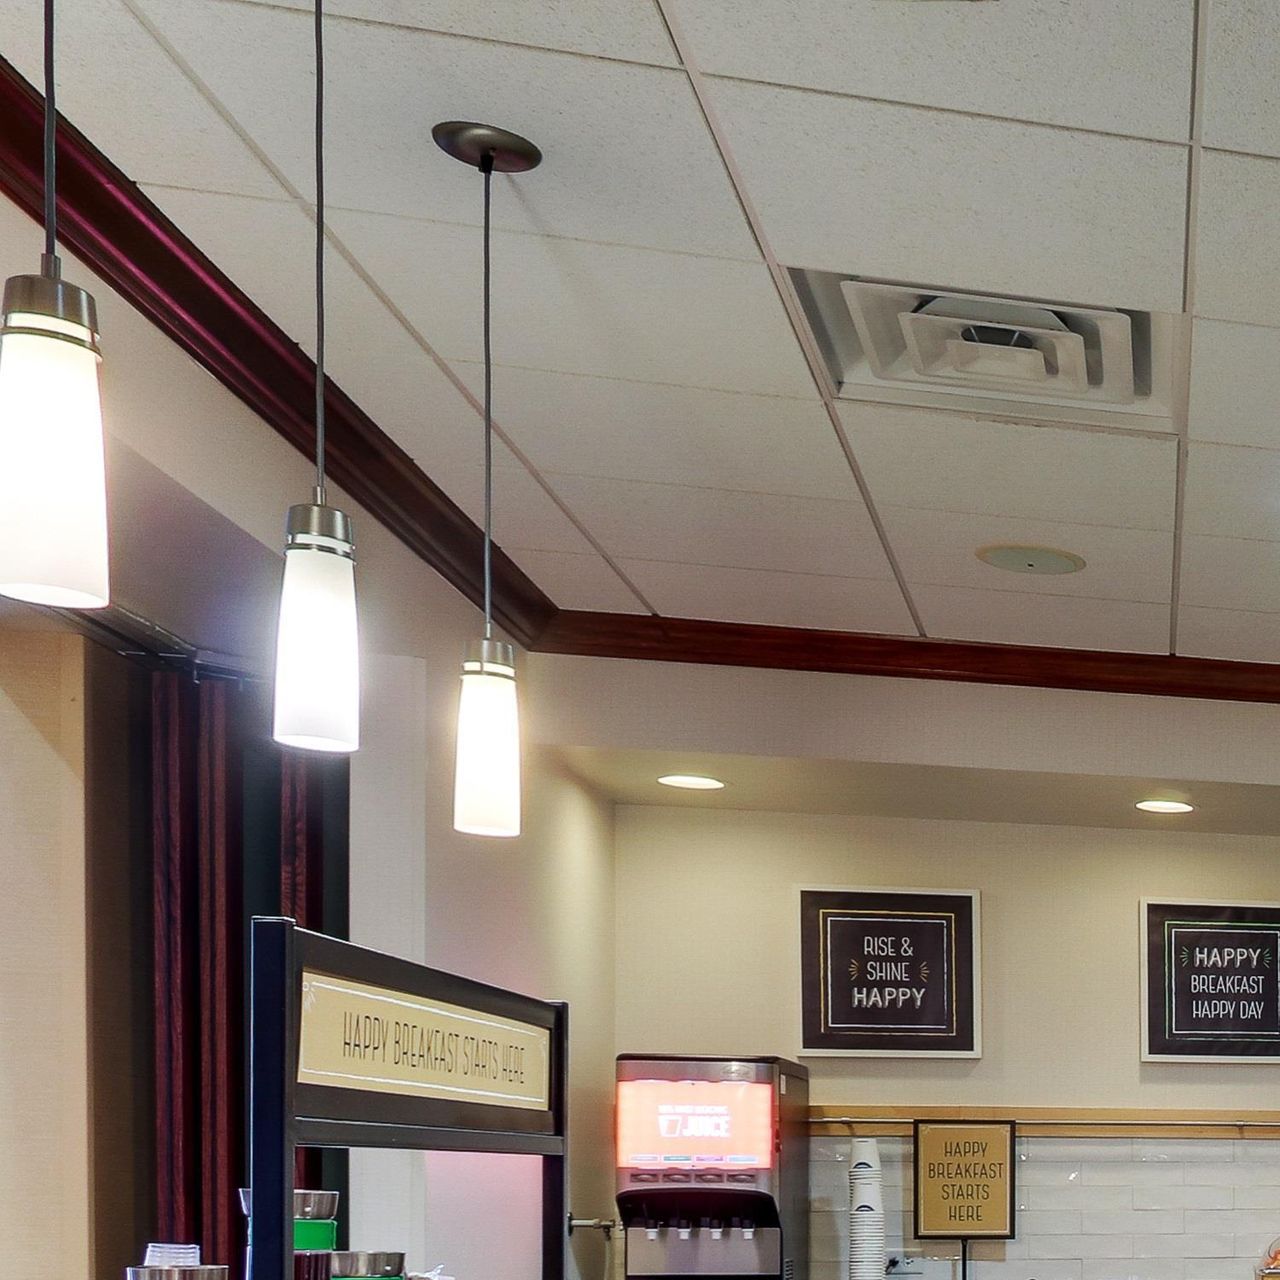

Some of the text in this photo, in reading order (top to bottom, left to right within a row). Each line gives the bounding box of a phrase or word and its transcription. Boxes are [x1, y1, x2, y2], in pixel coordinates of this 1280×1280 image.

[864, 936, 914, 957] RISE &
[1194, 947, 1261, 968] HAPPY
[866, 961, 910, 981] SHINE
[1191, 974, 1264, 994] BREAKFAST
[852, 987, 926, 1009] HAPPY
[1192, 1000, 1264, 1019] HAPPY DAY
[343, 1011, 524, 1084] HAPPY BREAKFAST STARTS HERE
[944, 1141, 988, 1157] HAPPY
[928, 1162, 1004, 1179] BREAKFAST
[941, 1183, 990, 1200] STARTS
[949, 1205, 983, 1221] HERE
